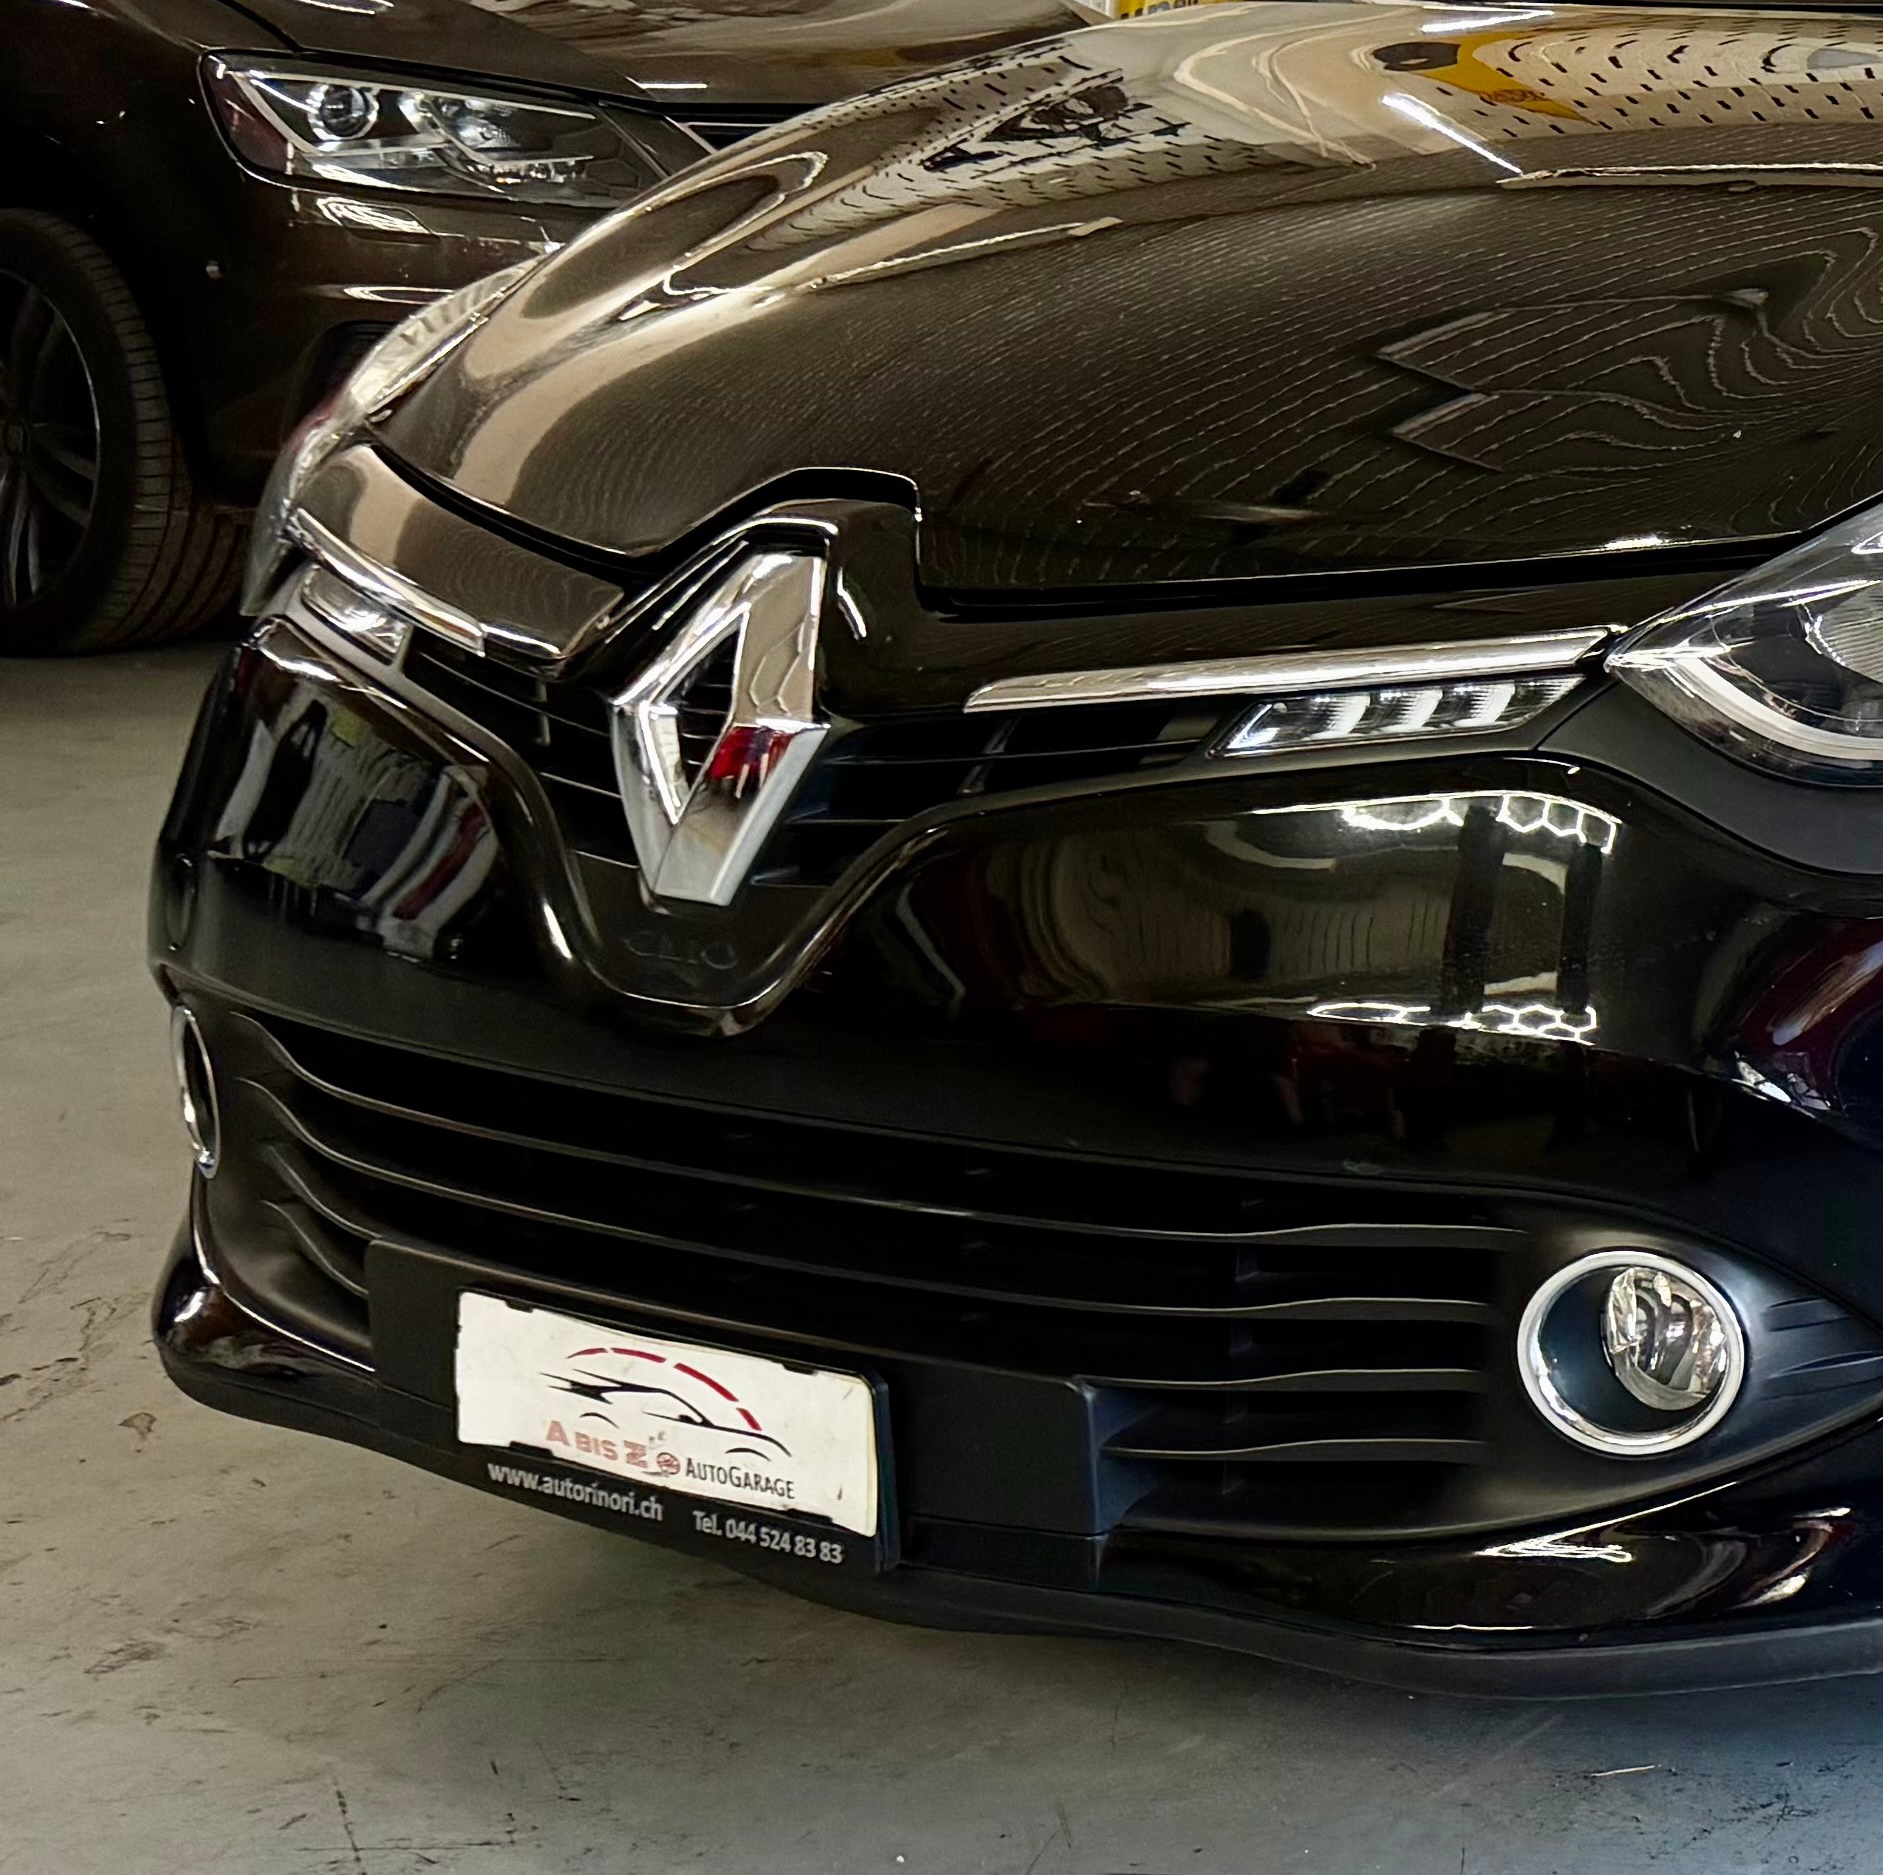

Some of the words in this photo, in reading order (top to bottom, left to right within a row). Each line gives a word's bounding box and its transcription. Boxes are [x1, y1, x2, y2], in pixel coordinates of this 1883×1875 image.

[621, 929, 740, 970] CLIO
[546, 1419, 571, 1447] A
[574, 1431, 619, 1462] BIS
[622, 1439, 649, 1470] Z
[486, 1462, 664, 1522] www.autorinori.ch
[685, 1457, 796, 1500] AUTOGARAGE
[692, 1509, 722, 1536] Tel.
[725, 1518, 758, 1544] 044
[759, 1526, 792, 1553] 524
[793, 1535, 817, 1559] 83
[819, 1541, 845, 1565] 83
